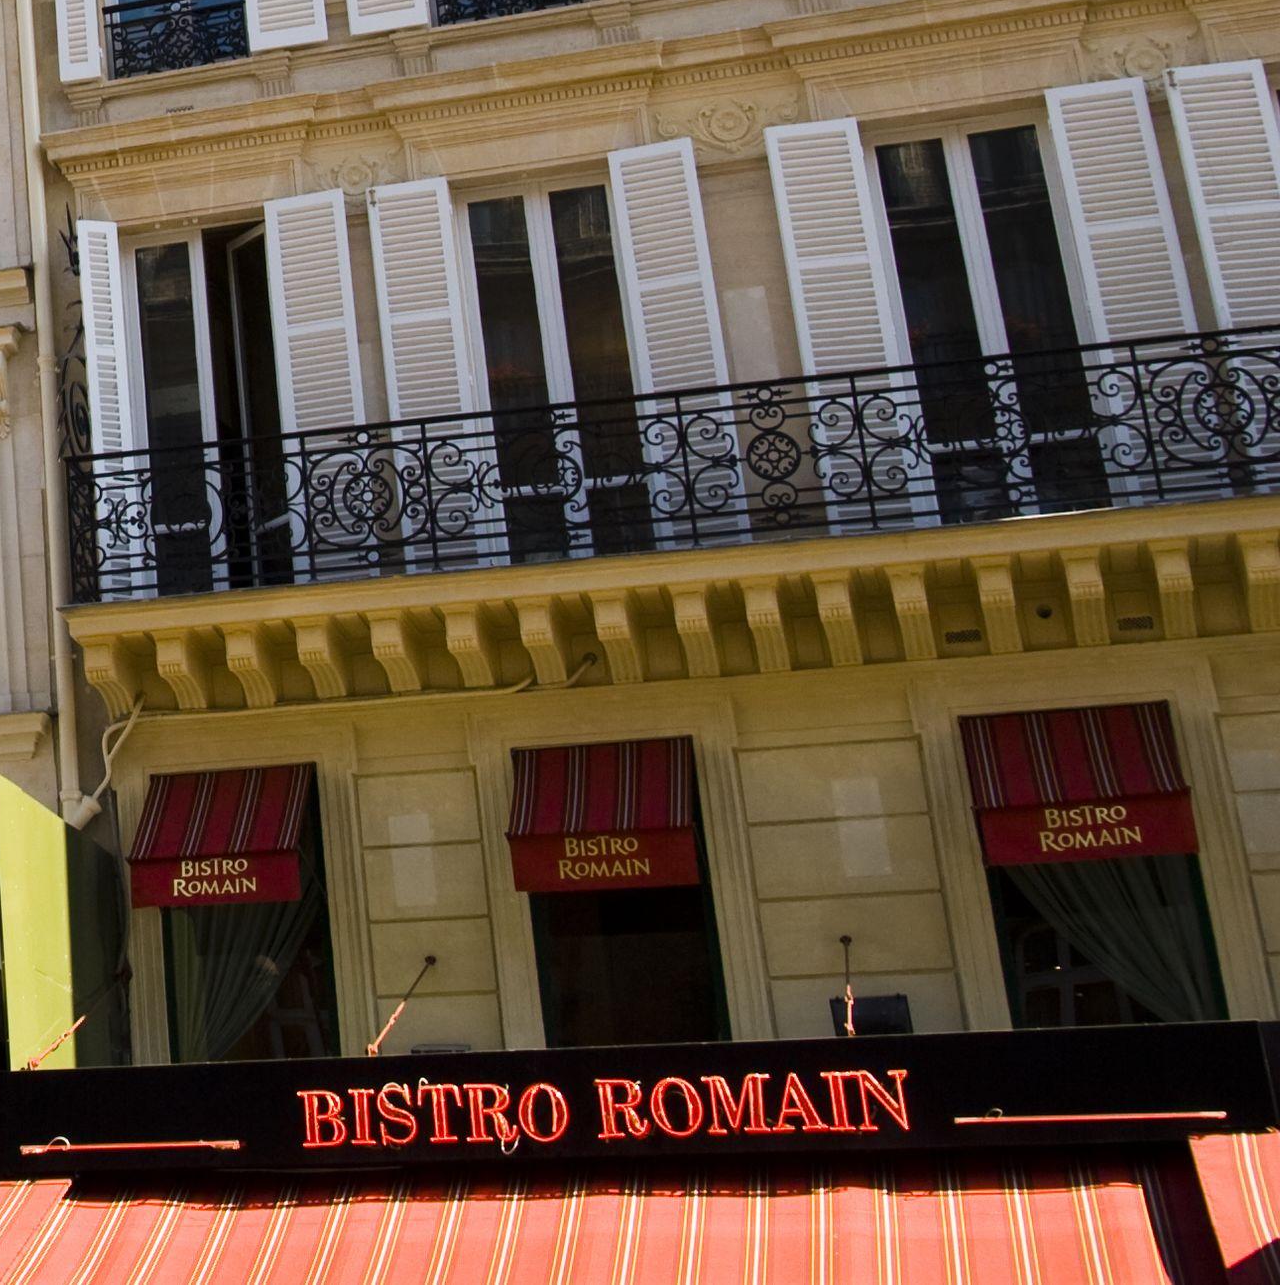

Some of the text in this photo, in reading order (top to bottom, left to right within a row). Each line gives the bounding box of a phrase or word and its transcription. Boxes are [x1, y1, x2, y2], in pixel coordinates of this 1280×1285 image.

[1044, 805, 1127, 828] BISTRO
[564, 836, 638, 857] BISTRO
[1040, 826, 1142, 852] ROMAIN
[181, 858, 248, 878] BISTRO
[558, 858, 650, 880] ROMAIN
[173, 877, 257, 897] ROMAIN
[296, 1069, 911, 1149] BISTRO ROMAIN
